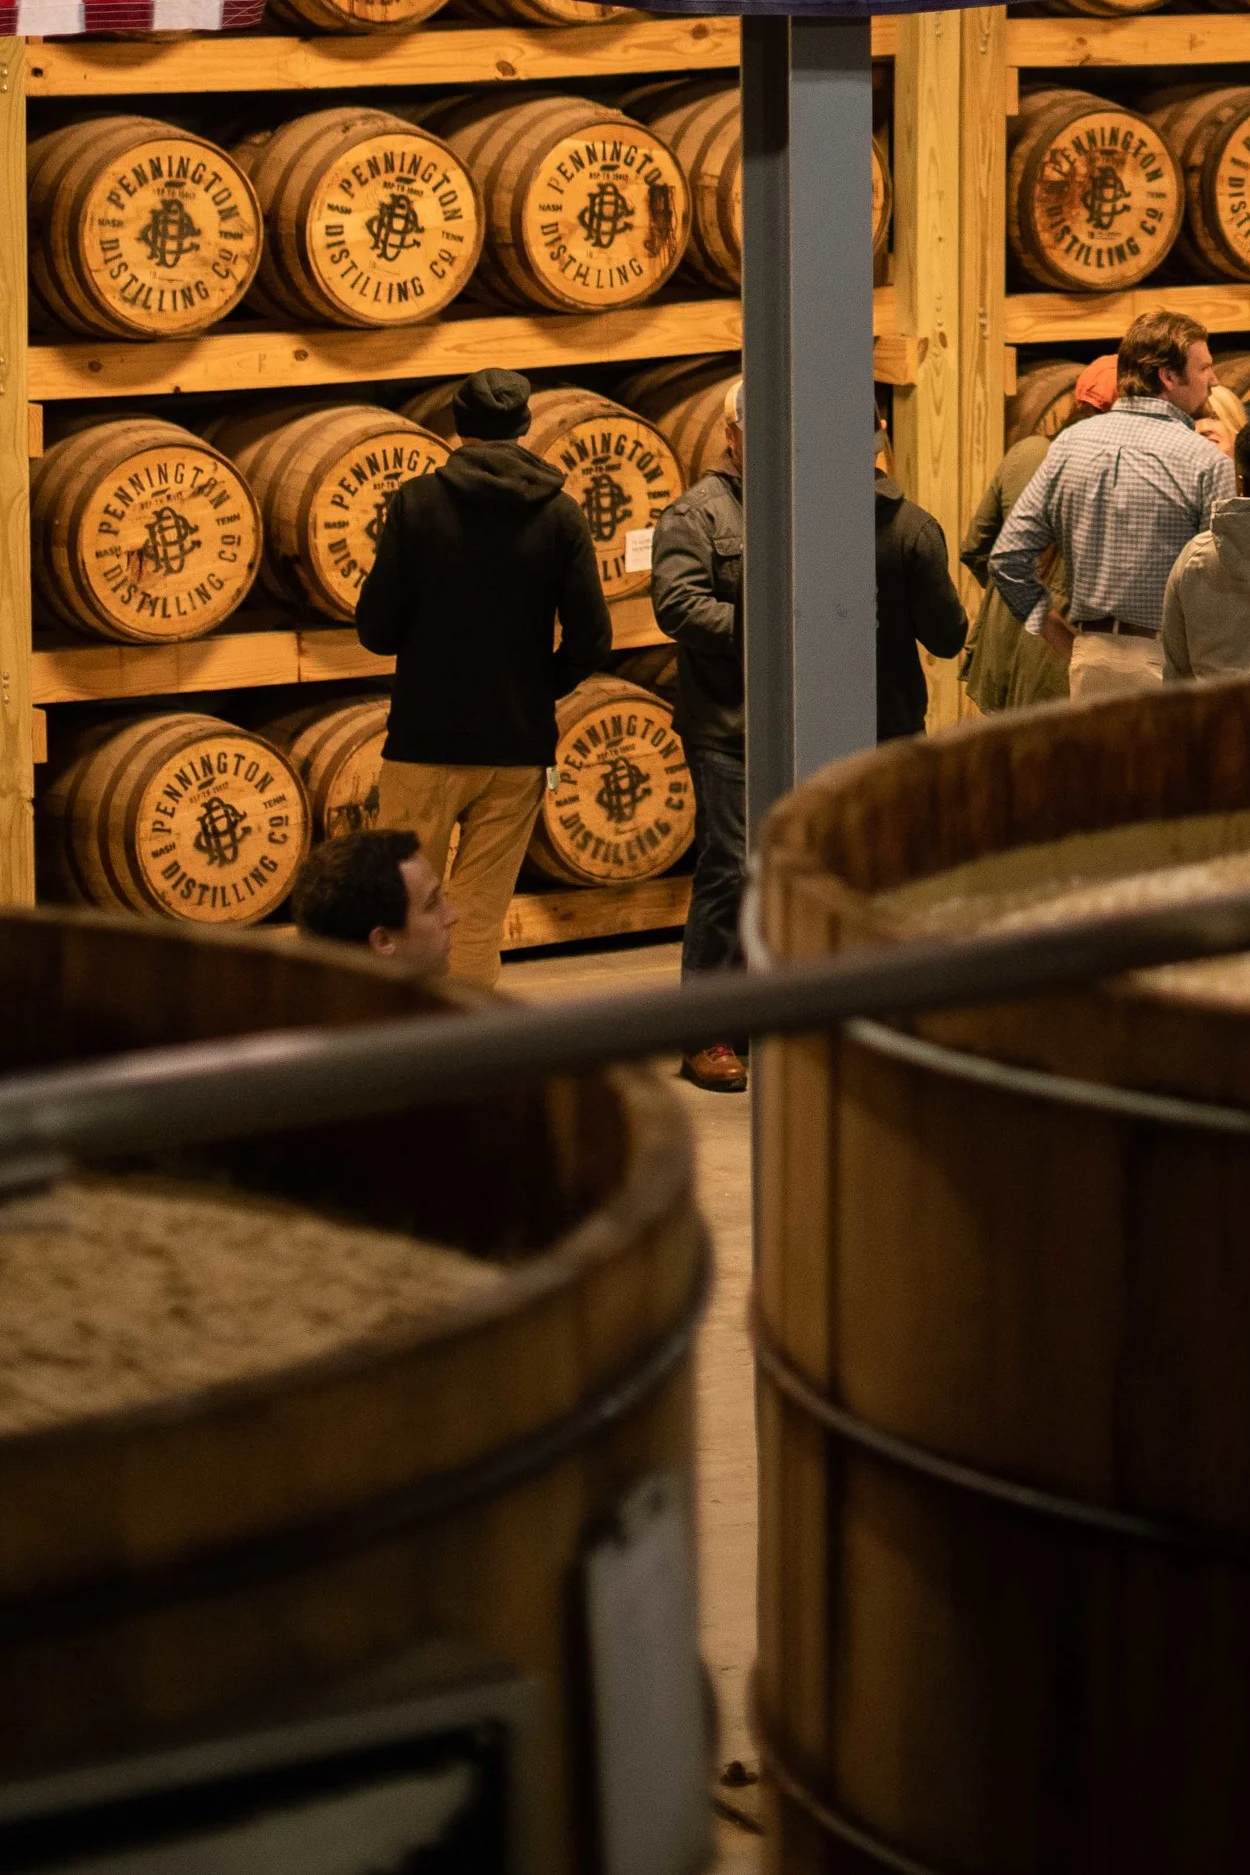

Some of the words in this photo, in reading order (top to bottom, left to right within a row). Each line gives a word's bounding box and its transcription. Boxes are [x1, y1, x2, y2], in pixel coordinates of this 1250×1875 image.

[106, 155, 240, 222] PENNINGTON
[338, 151, 464, 223] PENNINGTON
[546, 140, 668, 197] PENNINGTO
[1052, 126, 1164, 184] PENNINGTON
[326, 203, 352, 216] NASH
[538, 203, 563, 213] NASH
[100, 237, 210, 313] DISTILLING
[324, 223, 426, 304] DISTILLING
[428, 248, 456, 280] CO
[540, 220, 644, 290] DISTILLING
[330, 446, 437, 511] PENNINGT
[559, 432, 665, 485] NNINGTON
[97, 462, 231, 537] PENNINGTON
[215, 513, 242, 527] TENN
[103, 562, 225, 620] DISTILLING
[217, 533, 242, 564] CO
[559, 714, 681, 786] PENNINGTON
[151, 751, 275, 835] PENNINGTON
[262, 793, 288, 810] TENN
[151, 841, 177, 859] NASH
[161, 854, 279, 908] DISTILLING
[267, 815, 290, 845] CO
